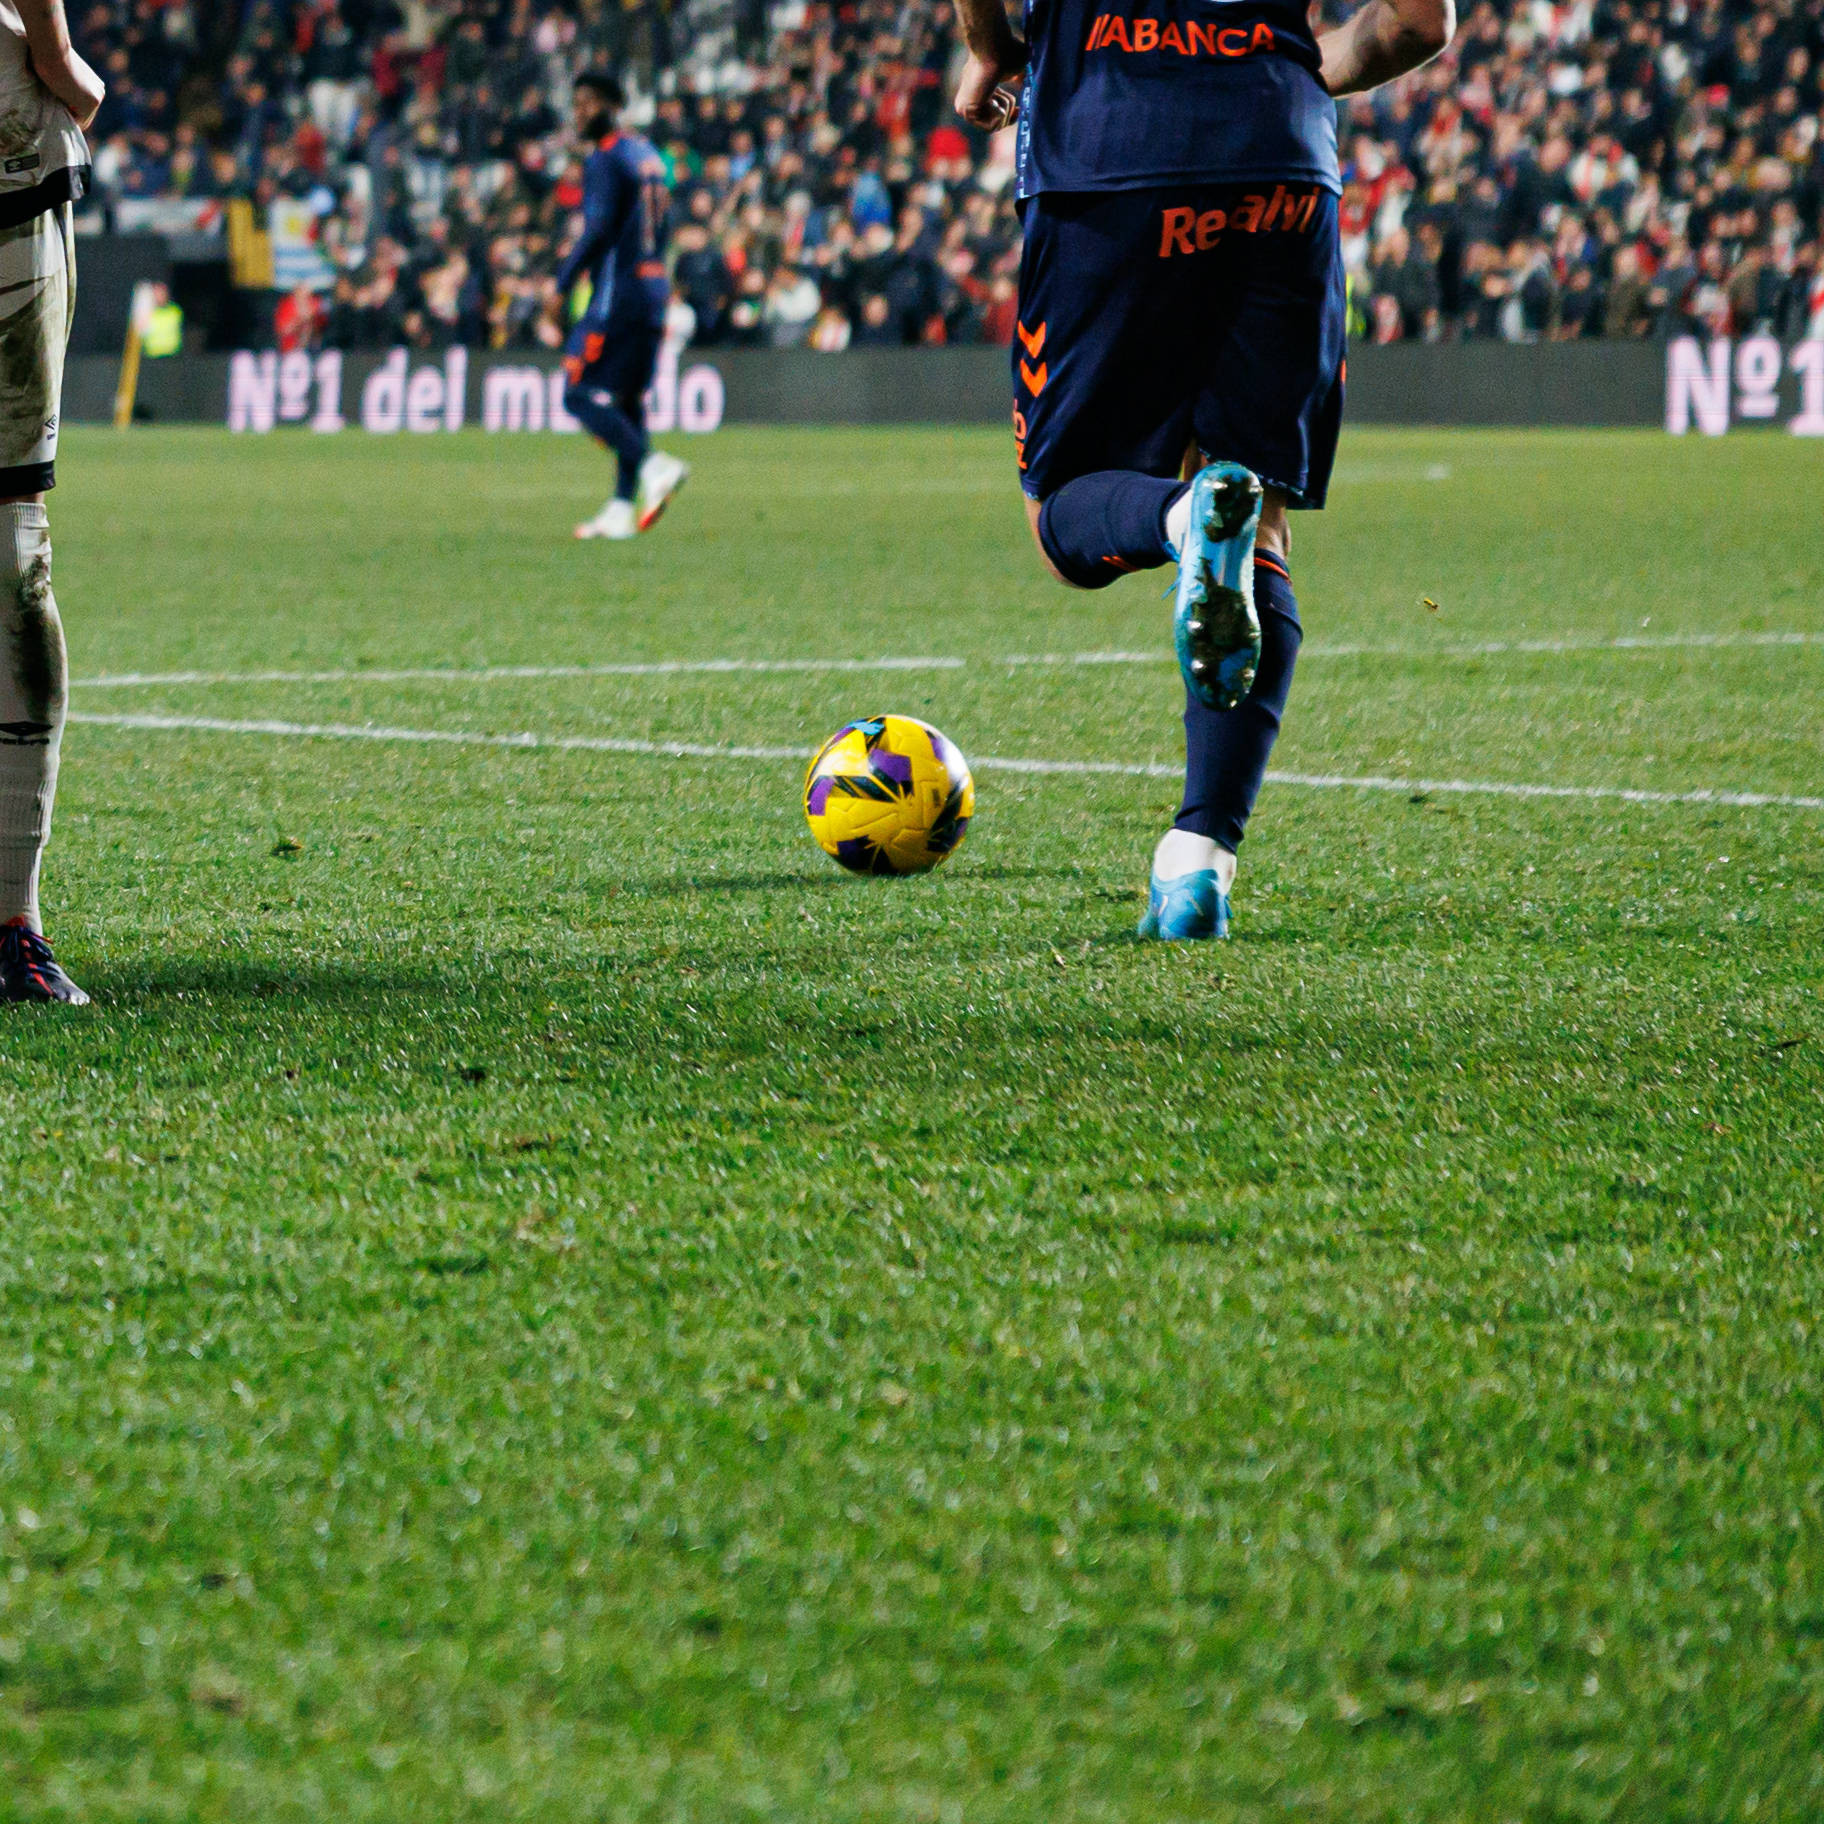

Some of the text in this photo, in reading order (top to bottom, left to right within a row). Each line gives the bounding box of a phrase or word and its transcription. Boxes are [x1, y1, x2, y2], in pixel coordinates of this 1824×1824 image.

[1094, 14, 1276, 58] ABANCA
[362, 344, 468, 433] del
[481, 346, 726, 433] mudo
